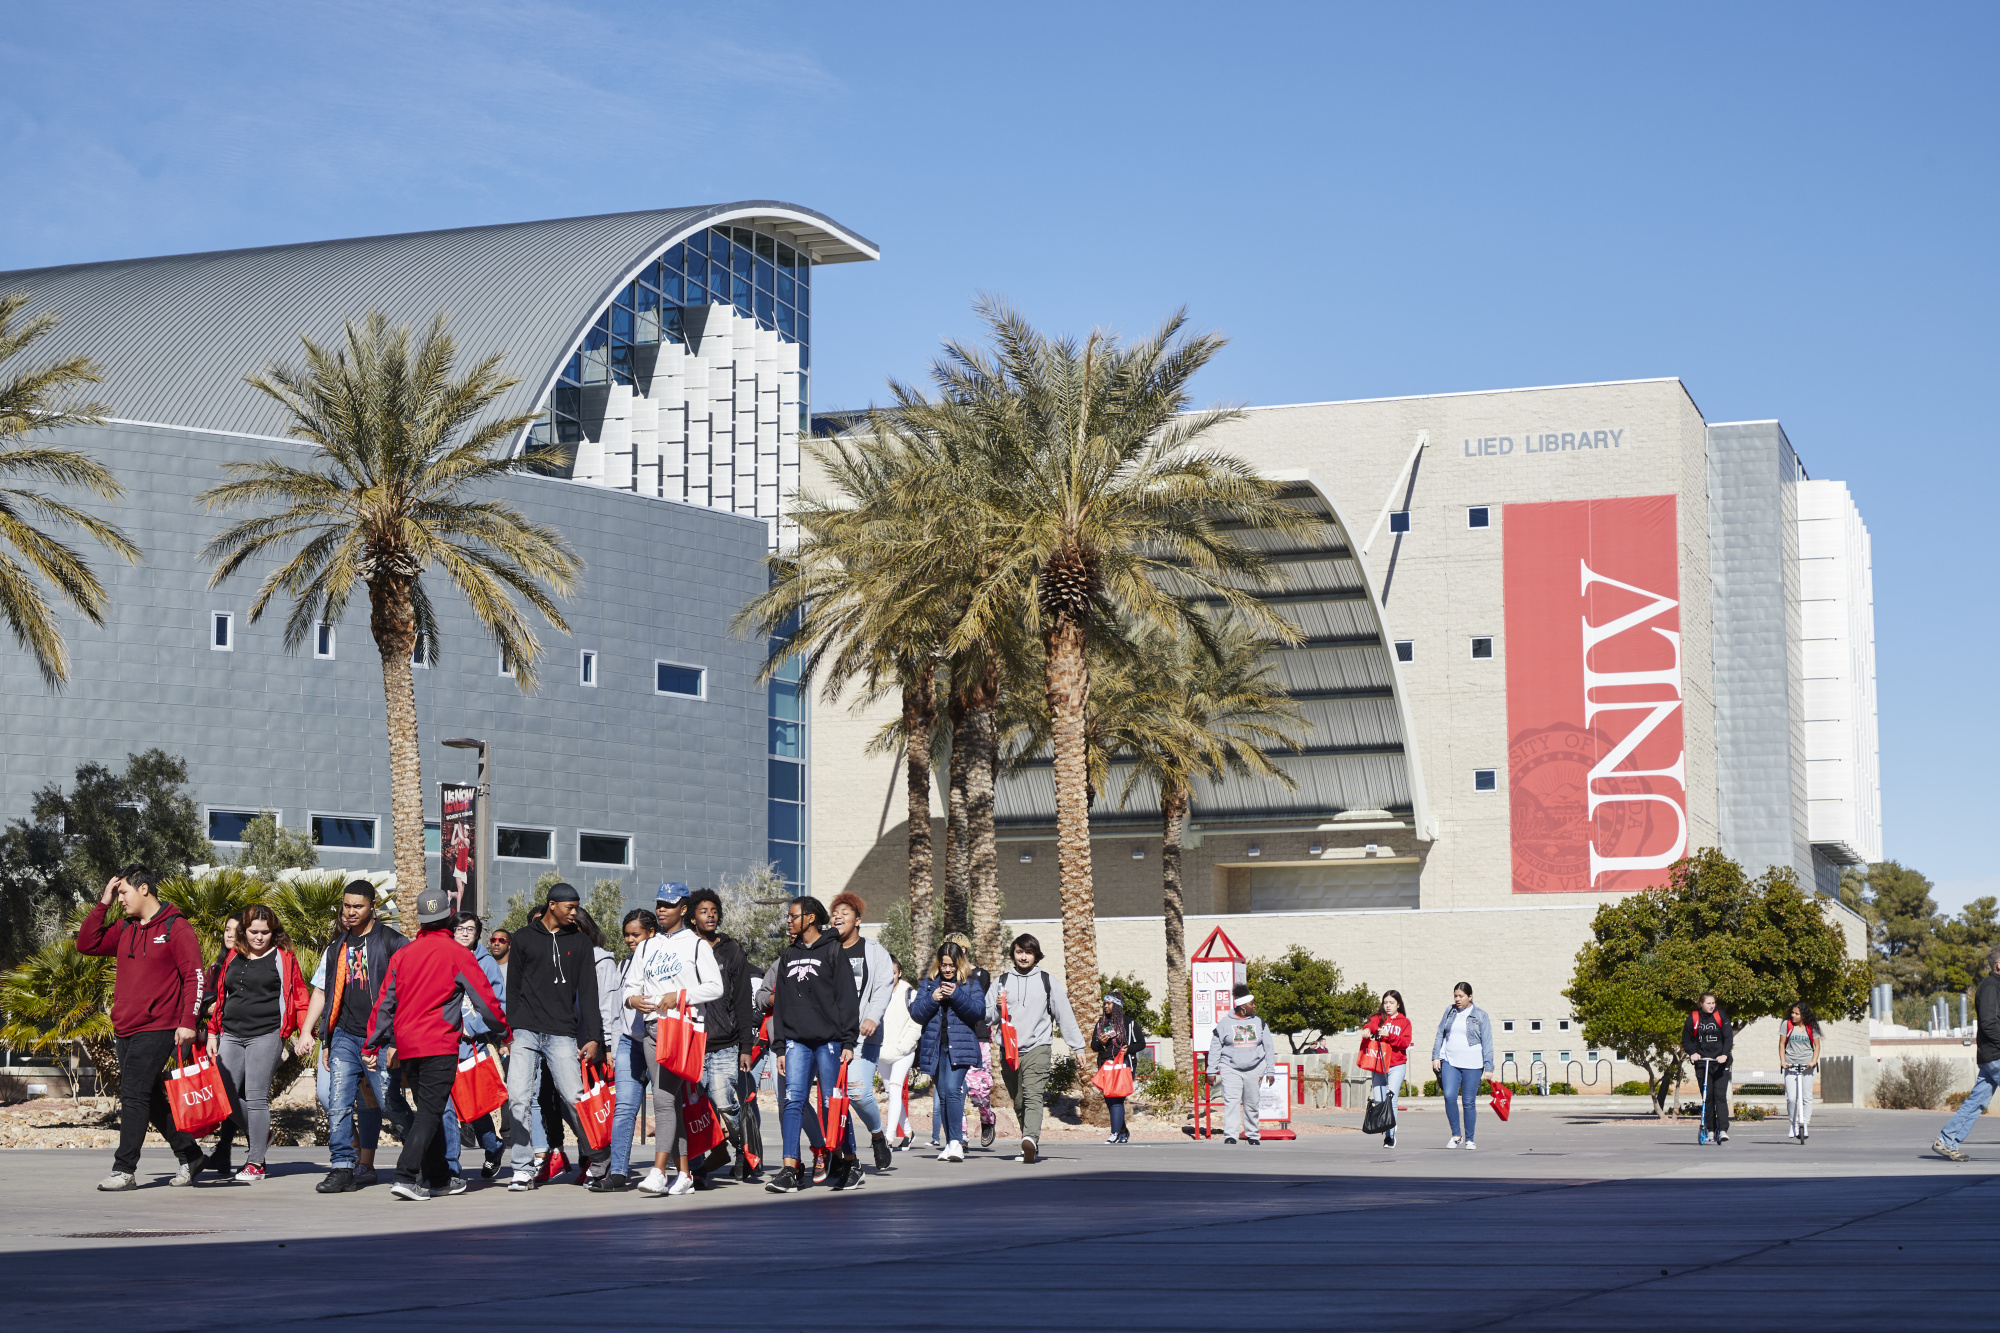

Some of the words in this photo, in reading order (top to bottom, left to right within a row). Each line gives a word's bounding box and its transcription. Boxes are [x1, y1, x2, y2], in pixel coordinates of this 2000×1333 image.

[1465, 436, 1514, 457] LIED
[1525, 428, 1624, 453] LIBRARY
[1580, 558, 1687, 888] UNLV
[1565, 733, 1594, 750] OF
[1512, 861, 1548, 891] LAS
[1553, 866, 1576, 874] PRO
[1196, 971, 1230, 984] UNLV
[192, 968, 205, 1016] HOLLISTER
[1196, 993, 1210, 1001] GET
[1216, 992, 1229, 1001] BE
[182, 1085, 214, 1106] UNLV
